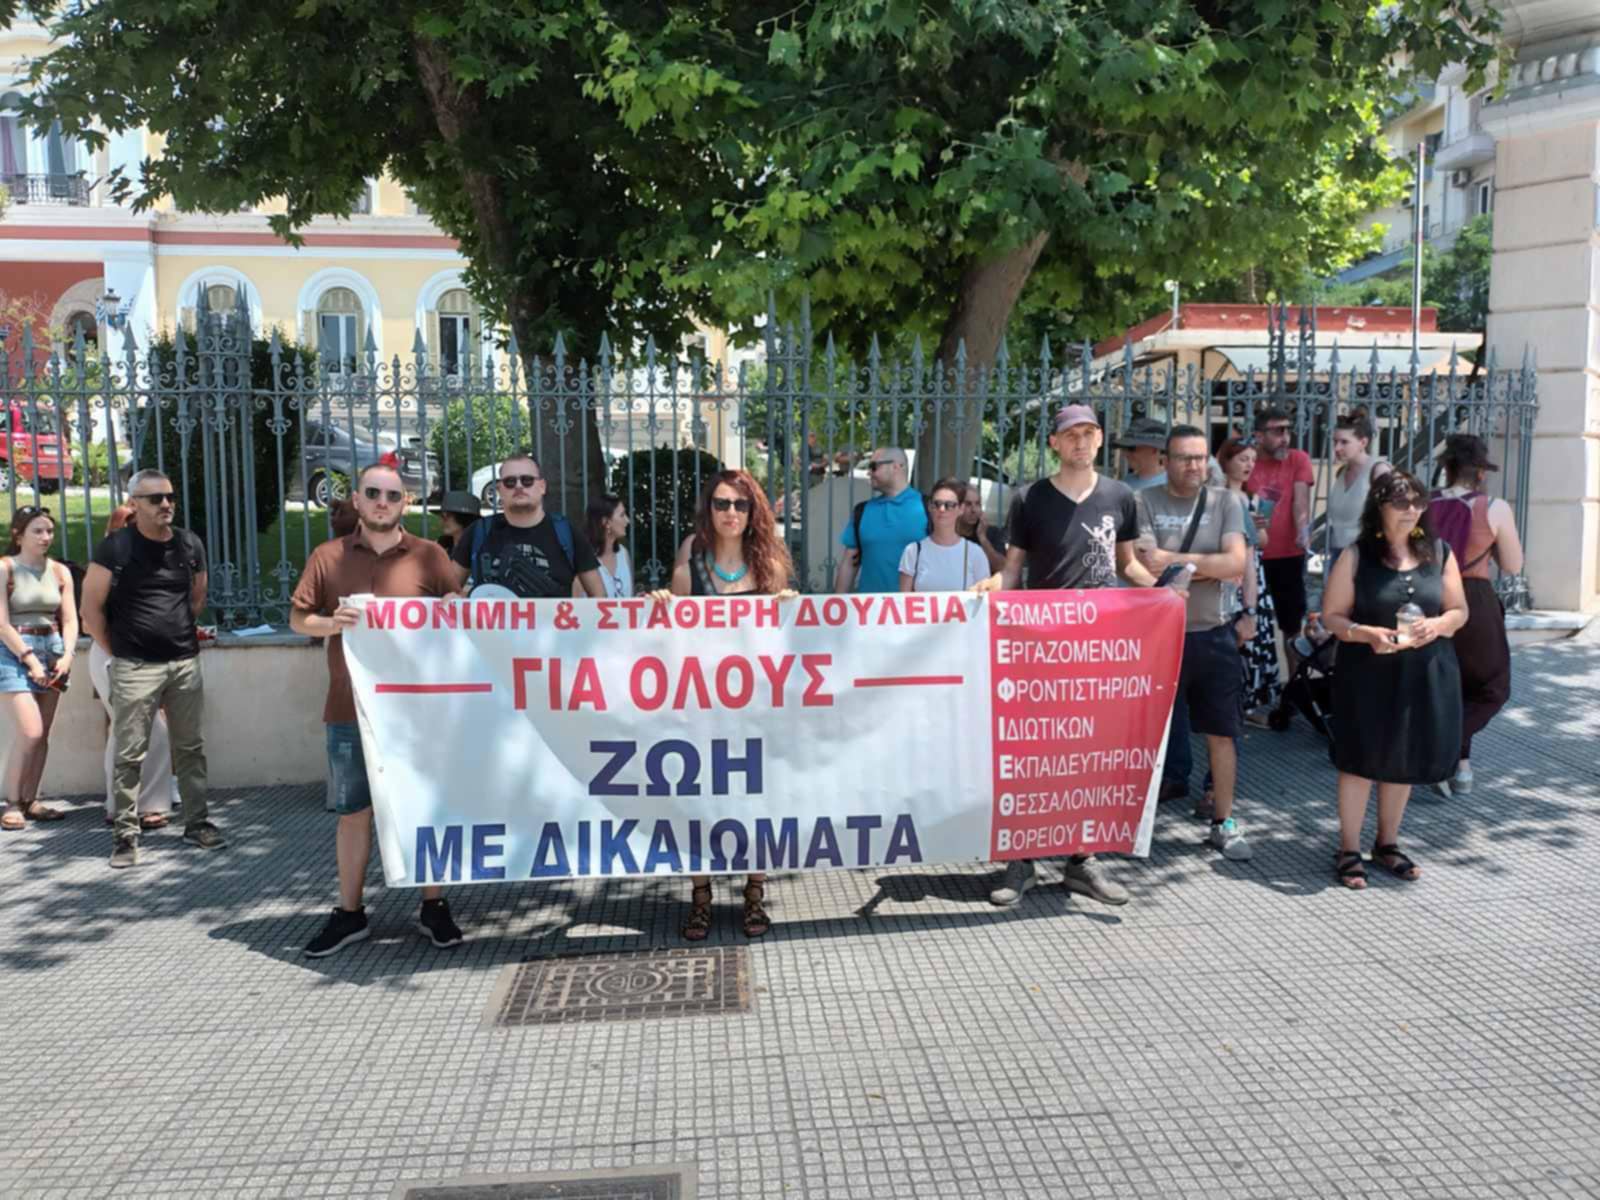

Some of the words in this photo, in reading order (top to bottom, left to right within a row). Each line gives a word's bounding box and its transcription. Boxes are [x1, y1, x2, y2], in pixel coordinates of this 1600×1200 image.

[365, 600, 536, 630] ΜΟΝΙΜΗ
[553, 601, 580, 630] &
[598, 598, 781, 630] ΣΤΑΘΕΡΗ
[795, 596, 967, 627] ΔΟΥΛΕΙΑ
[995, 600, 1098, 626] ΣΩΜΑΤΕΙΟ
[996, 638, 1141, 664] ΕΡΓΑΖΟΜΕΝΩΝ
[512, 656, 608, 711] ΓΙΑ
[629, 653, 834, 712] ΟΛΟΥΣ
[997, 675, 1152, 703] ΦΡΟΝΤΙΣΤΗΡΙΩΝ
[998, 716, 1095, 741] ΙΔΙΩΤΙΚΩΝ
[588, 737, 763, 797] ΖΩΗ
[999, 747, 1157, 779] ΕΚΠΑΙΔΕΥΤΗΡΙΩΝ
[415, 823, 507, 884] ΜΕ
[529, 813, 923, 879] ΔΙΚΑΙΩΜΑΤΑ
[997, 823, 1077, 852] ΒΟΡΕΙΟΥ
[1081, 819, 1138, 844] ΕΛΛΑ
